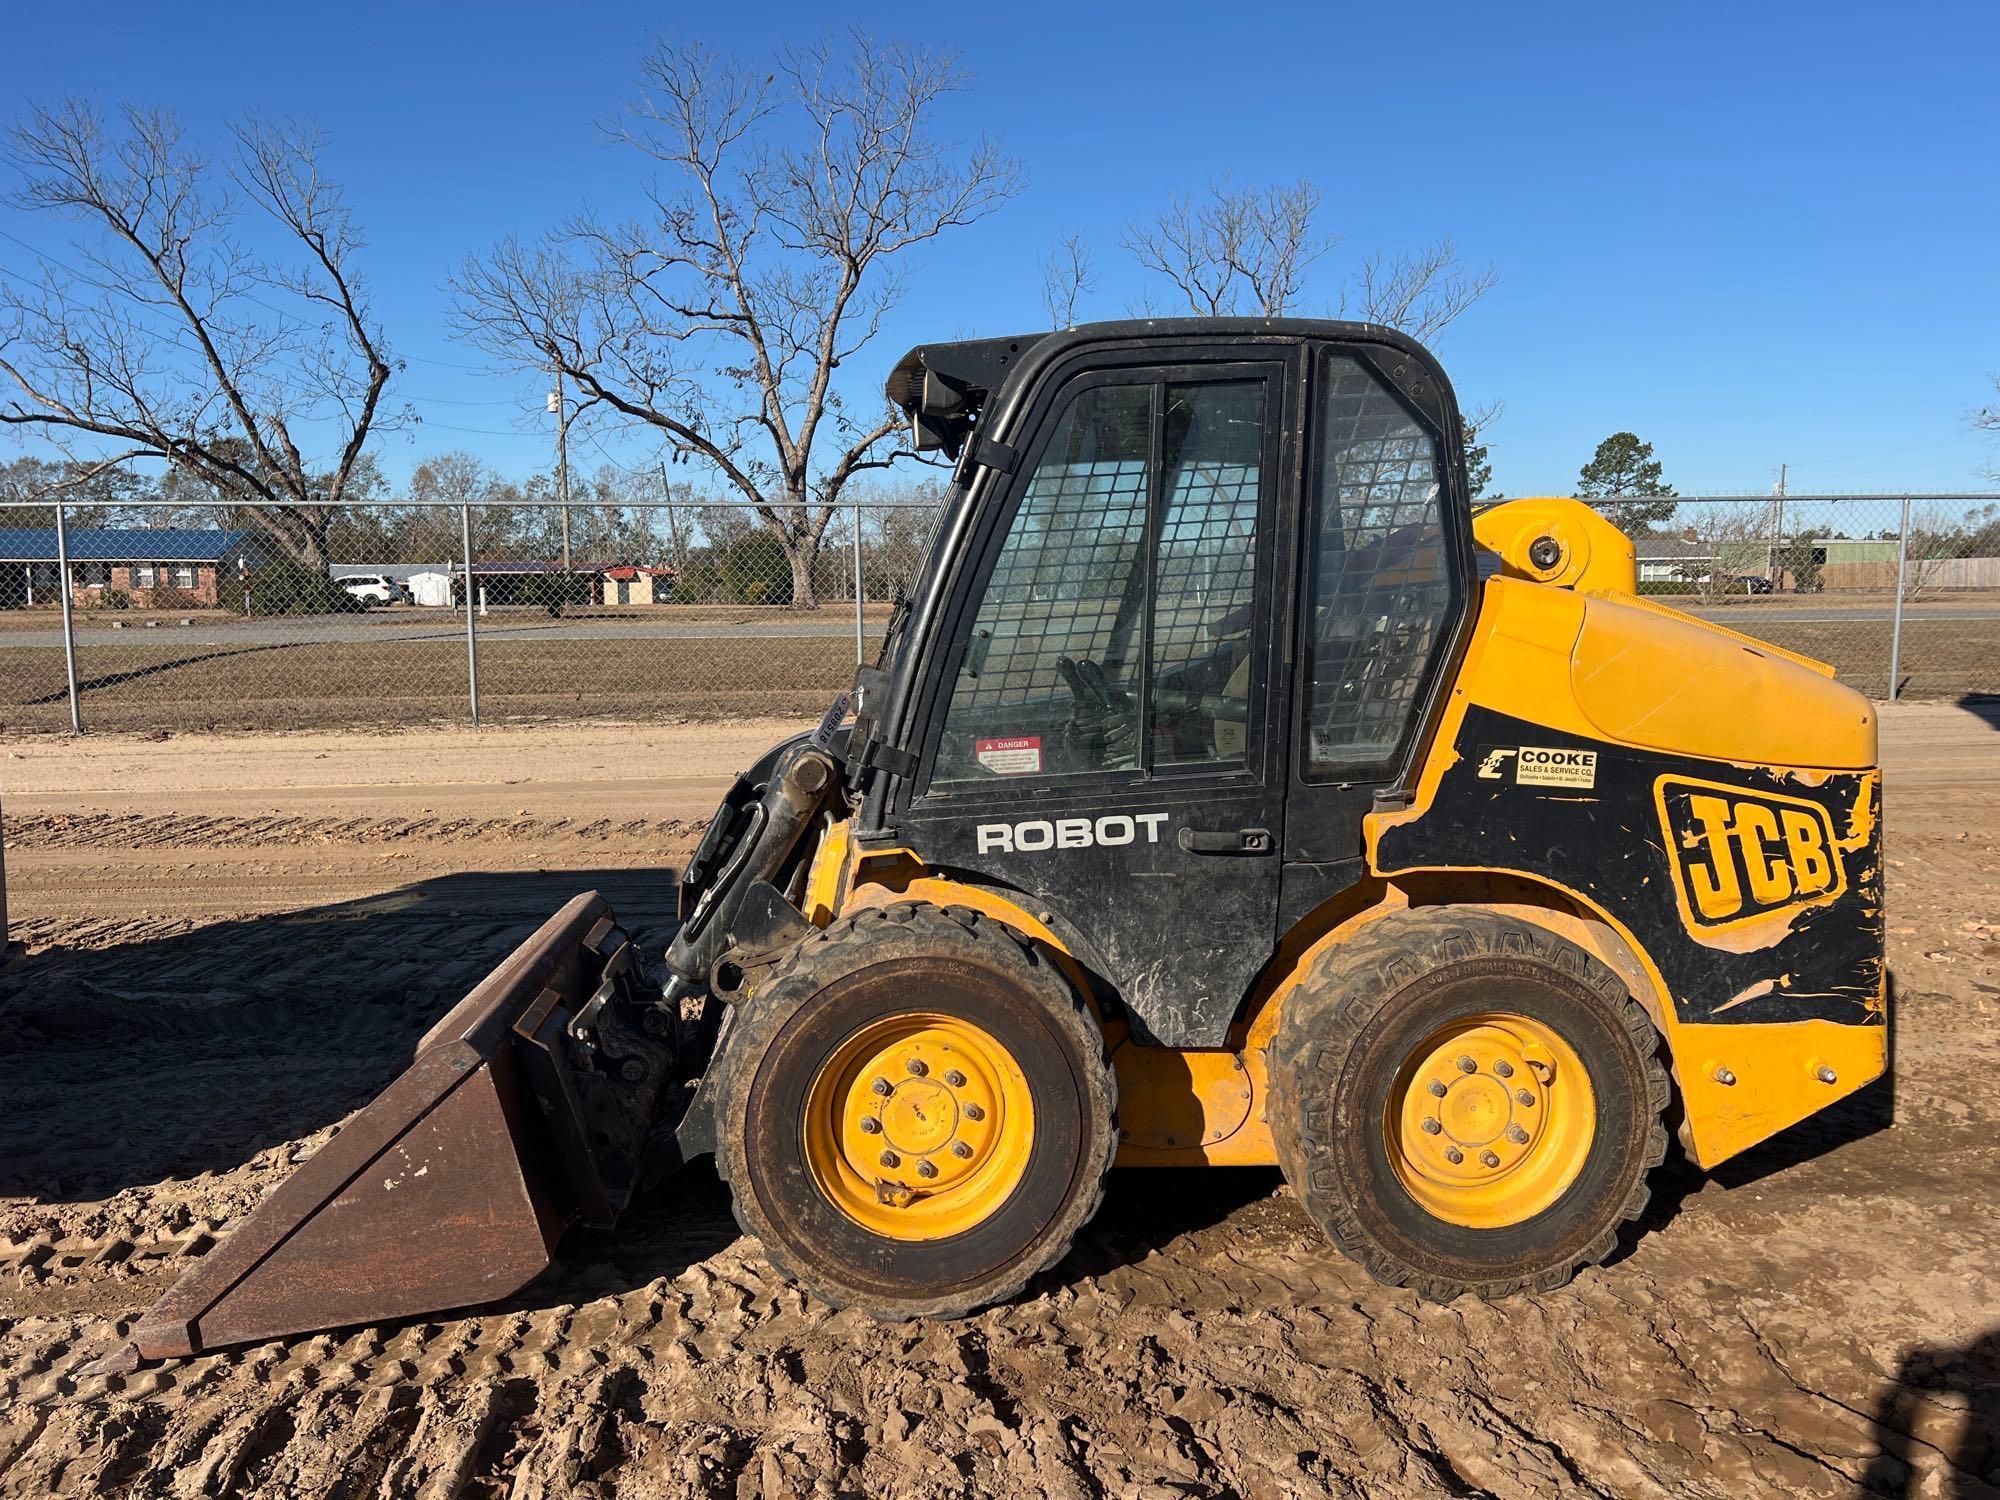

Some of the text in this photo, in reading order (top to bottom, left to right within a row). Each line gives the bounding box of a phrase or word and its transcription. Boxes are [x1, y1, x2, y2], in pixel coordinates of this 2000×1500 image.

[820, 706, 845, 743] 208518
[997, 741, 1029, 749] DANGER
[1520, 765, 1542, 773] SALES
[1581, 769, 1593, 777] CO.
[1521, 751, 1594, 766] COOKE
[977, 813, 1169, 854] ROBOT
[1688, 795, 1831, 919] JCB
